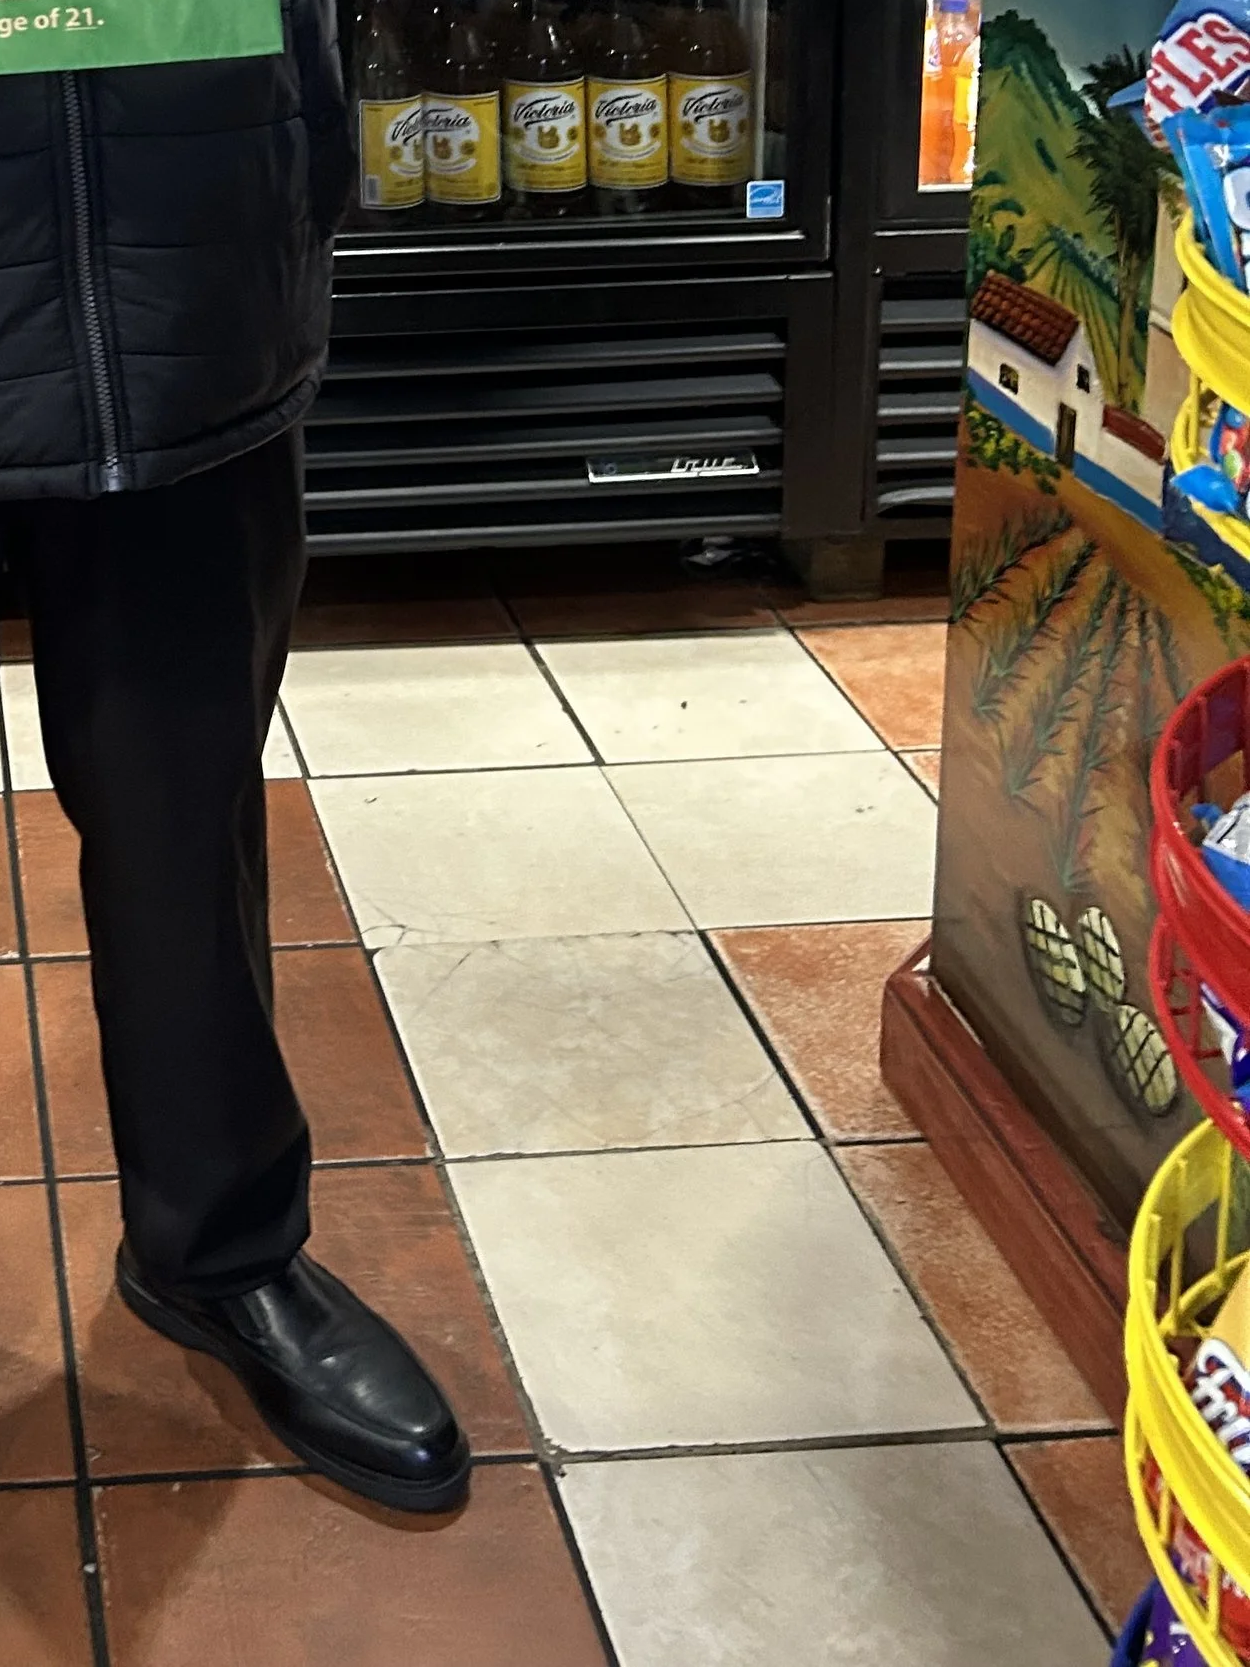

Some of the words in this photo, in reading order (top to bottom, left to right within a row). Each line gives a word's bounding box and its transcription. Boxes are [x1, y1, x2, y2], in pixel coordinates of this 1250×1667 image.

[34, 7, 61, 28] of
[65, 7, 104, 31] 21.
[513, 94, 575, 130] Victoria
[595, 92, 657, 127] Victoria
[683, 88, 744, 124] Victoria
